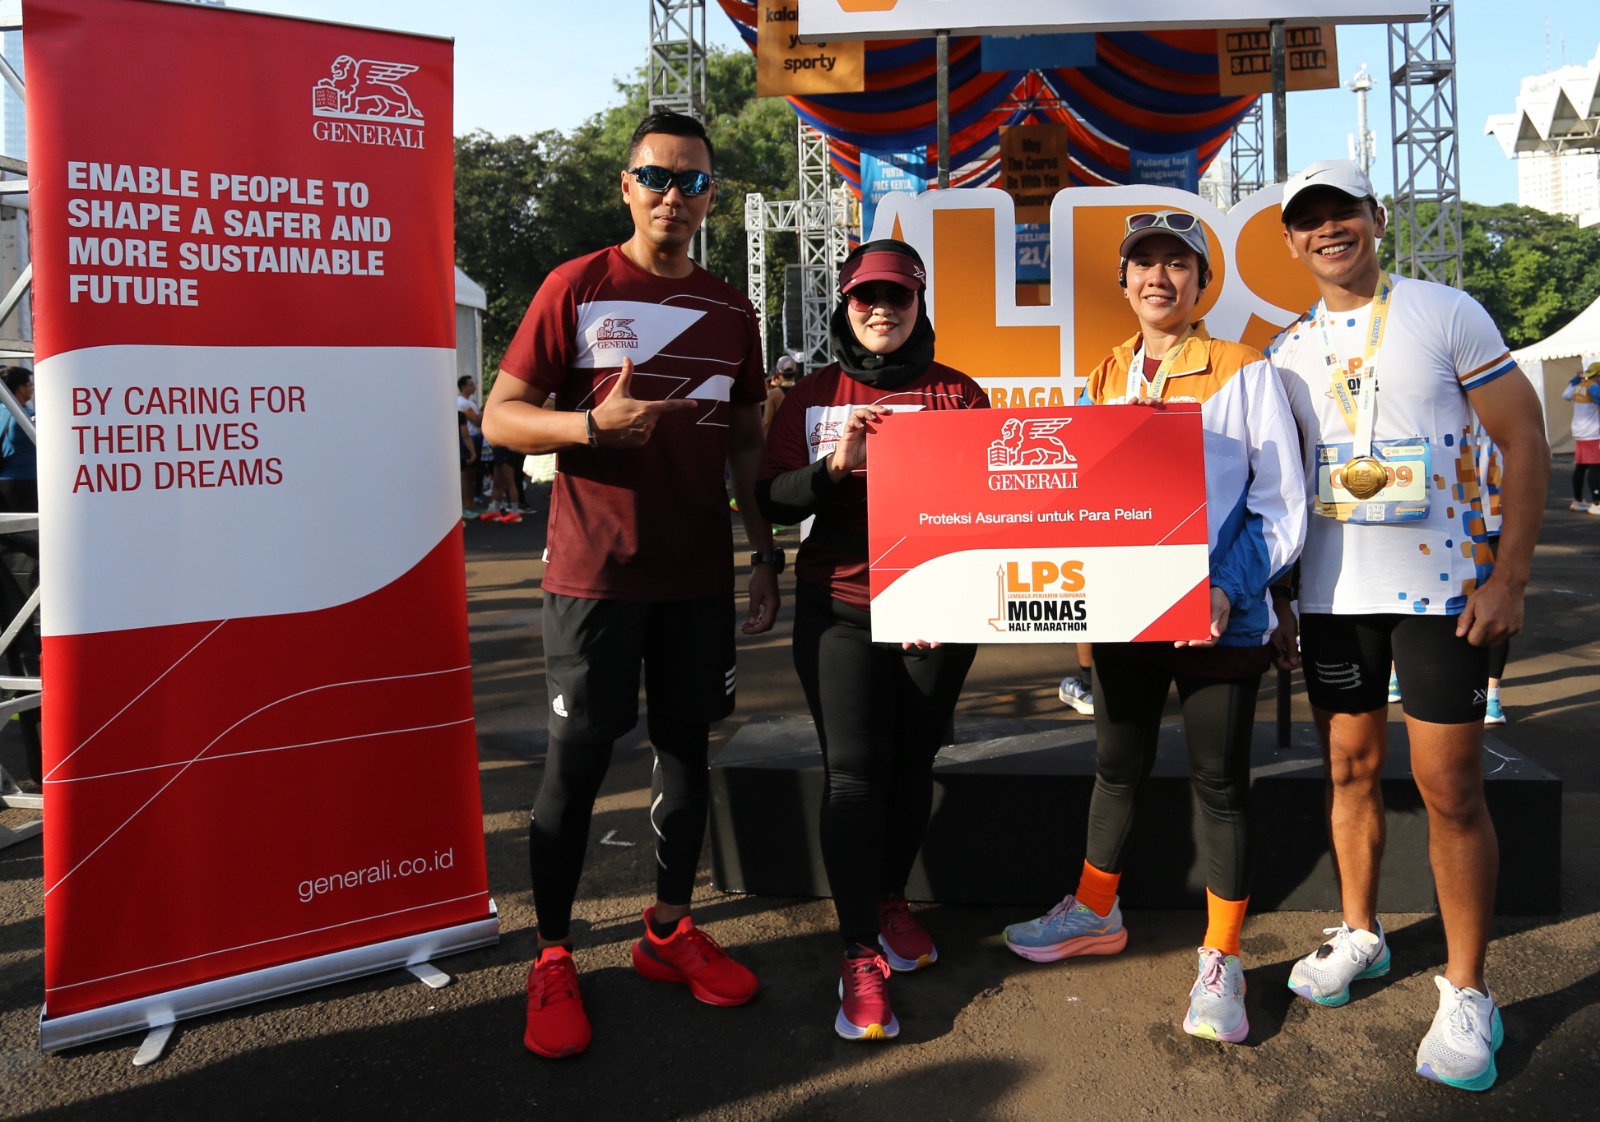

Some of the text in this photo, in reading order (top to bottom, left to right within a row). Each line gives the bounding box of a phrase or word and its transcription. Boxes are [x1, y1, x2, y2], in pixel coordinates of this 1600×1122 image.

[766, 6, 798, 22] kala
[1227, 29, 1320, 51] MALA LARI
[784, 54, 836, 73] sporty
[1291, 51, 1326, 69] GILA
[312, 120, 425, 149] GENERALI
[1022, 139, 1041, 153] May
[1008, 156, 1058, 171] The Course
[1136, 156, 1188, 168] Pulang lari
[68, 161, 369, 208] ENABLE PEOPLE TO
[1007, 174, 1060, 189] Be With You
[68, 198, 391, 243] SHAPE A SAFER AND
[68, 236, 385, 277] MORE SUSTAINABLE
[69, 274, 199, 307] FUTURE
[597, 341, 639, 349] GENERALI
[72, 385, 306, 417] BY CARING FOR
[983, 386, 1065, 408] BAGA
[72, 422, 259, 455] THEIR LIVES
[812, 442, 837, 454] GENERA
[72, 457, 284, 494] AND DREAMS
[988, 472, 1078, 491] GENERALI
[919, 507, 1153, 525] Proteksi Asuransi untuk Para Pelari
[1007, 560, 1086, 593] LPS
[1008, 600, 1087, 621] MONAS
[1008, 621, 1087, 632] HALF MARATHON
[298, 847, 454, 903] generali.co.id
